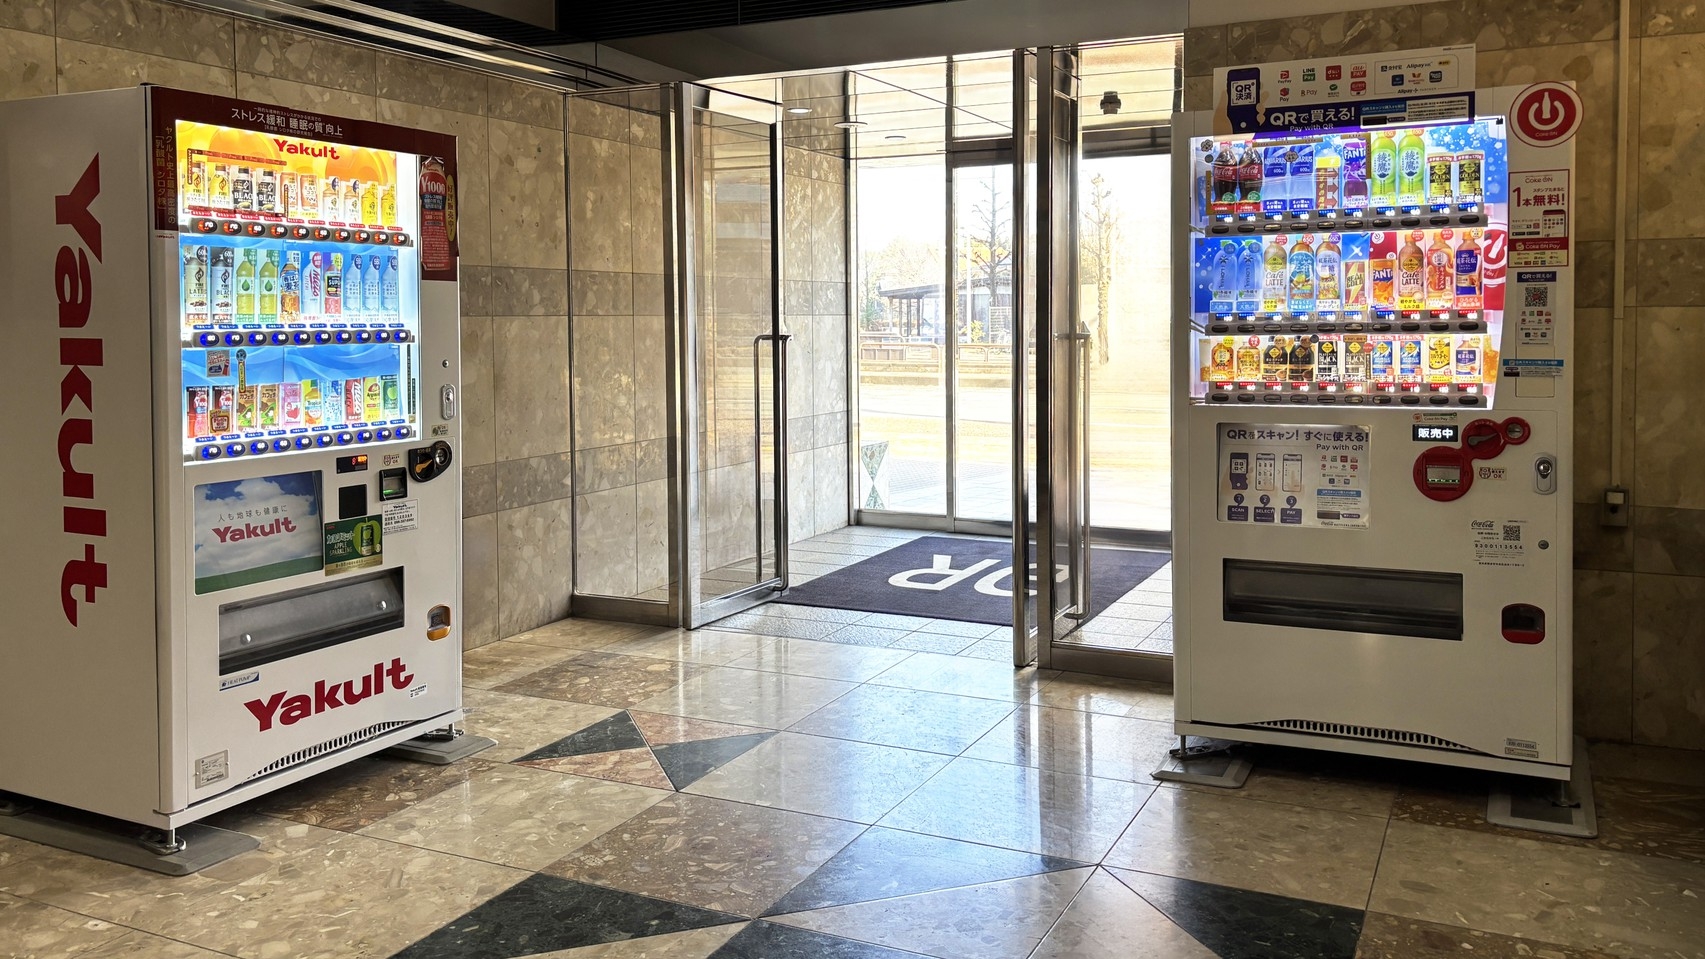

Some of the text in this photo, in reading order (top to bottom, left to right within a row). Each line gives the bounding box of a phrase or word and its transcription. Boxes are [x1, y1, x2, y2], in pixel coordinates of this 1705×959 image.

[1235, 84, 1251, 93] QR
[1236, 93, 1252, 101] 決済
[231, 108, 286, 128] ストレス緩和
[1270, 107, 1355, 126] QRで買える!
[273, 138, 340, 160] Yakult
[1344, 148, 1366, 159] FANT
[1377, 152, 1388, 173] 綾鷹
[1405, 150, 1416, 171] 綾鷹
[421, 176, 445, 193] Y1000
[234, 191, 253, 199] BLAC
[1512, 186, 1565, 208] 1本無料!
[1265, 271, 1284, 279] Café
[1373, 268, 1393, 279] FANT
[1402, 271, 1419, 279] Café
[55, 152, 108, 627] Yakult
[1304, 430, 1368, 442] すぐに使える!
[1418, 428, 1453, 438] 販売中
[1316, 443, 1330, 451] Pay
[218, 505, 287, 522] 人も地球も健康に
[212, 517, 297, 543] Yakult
[244, 657, 414, 732] Yakult
